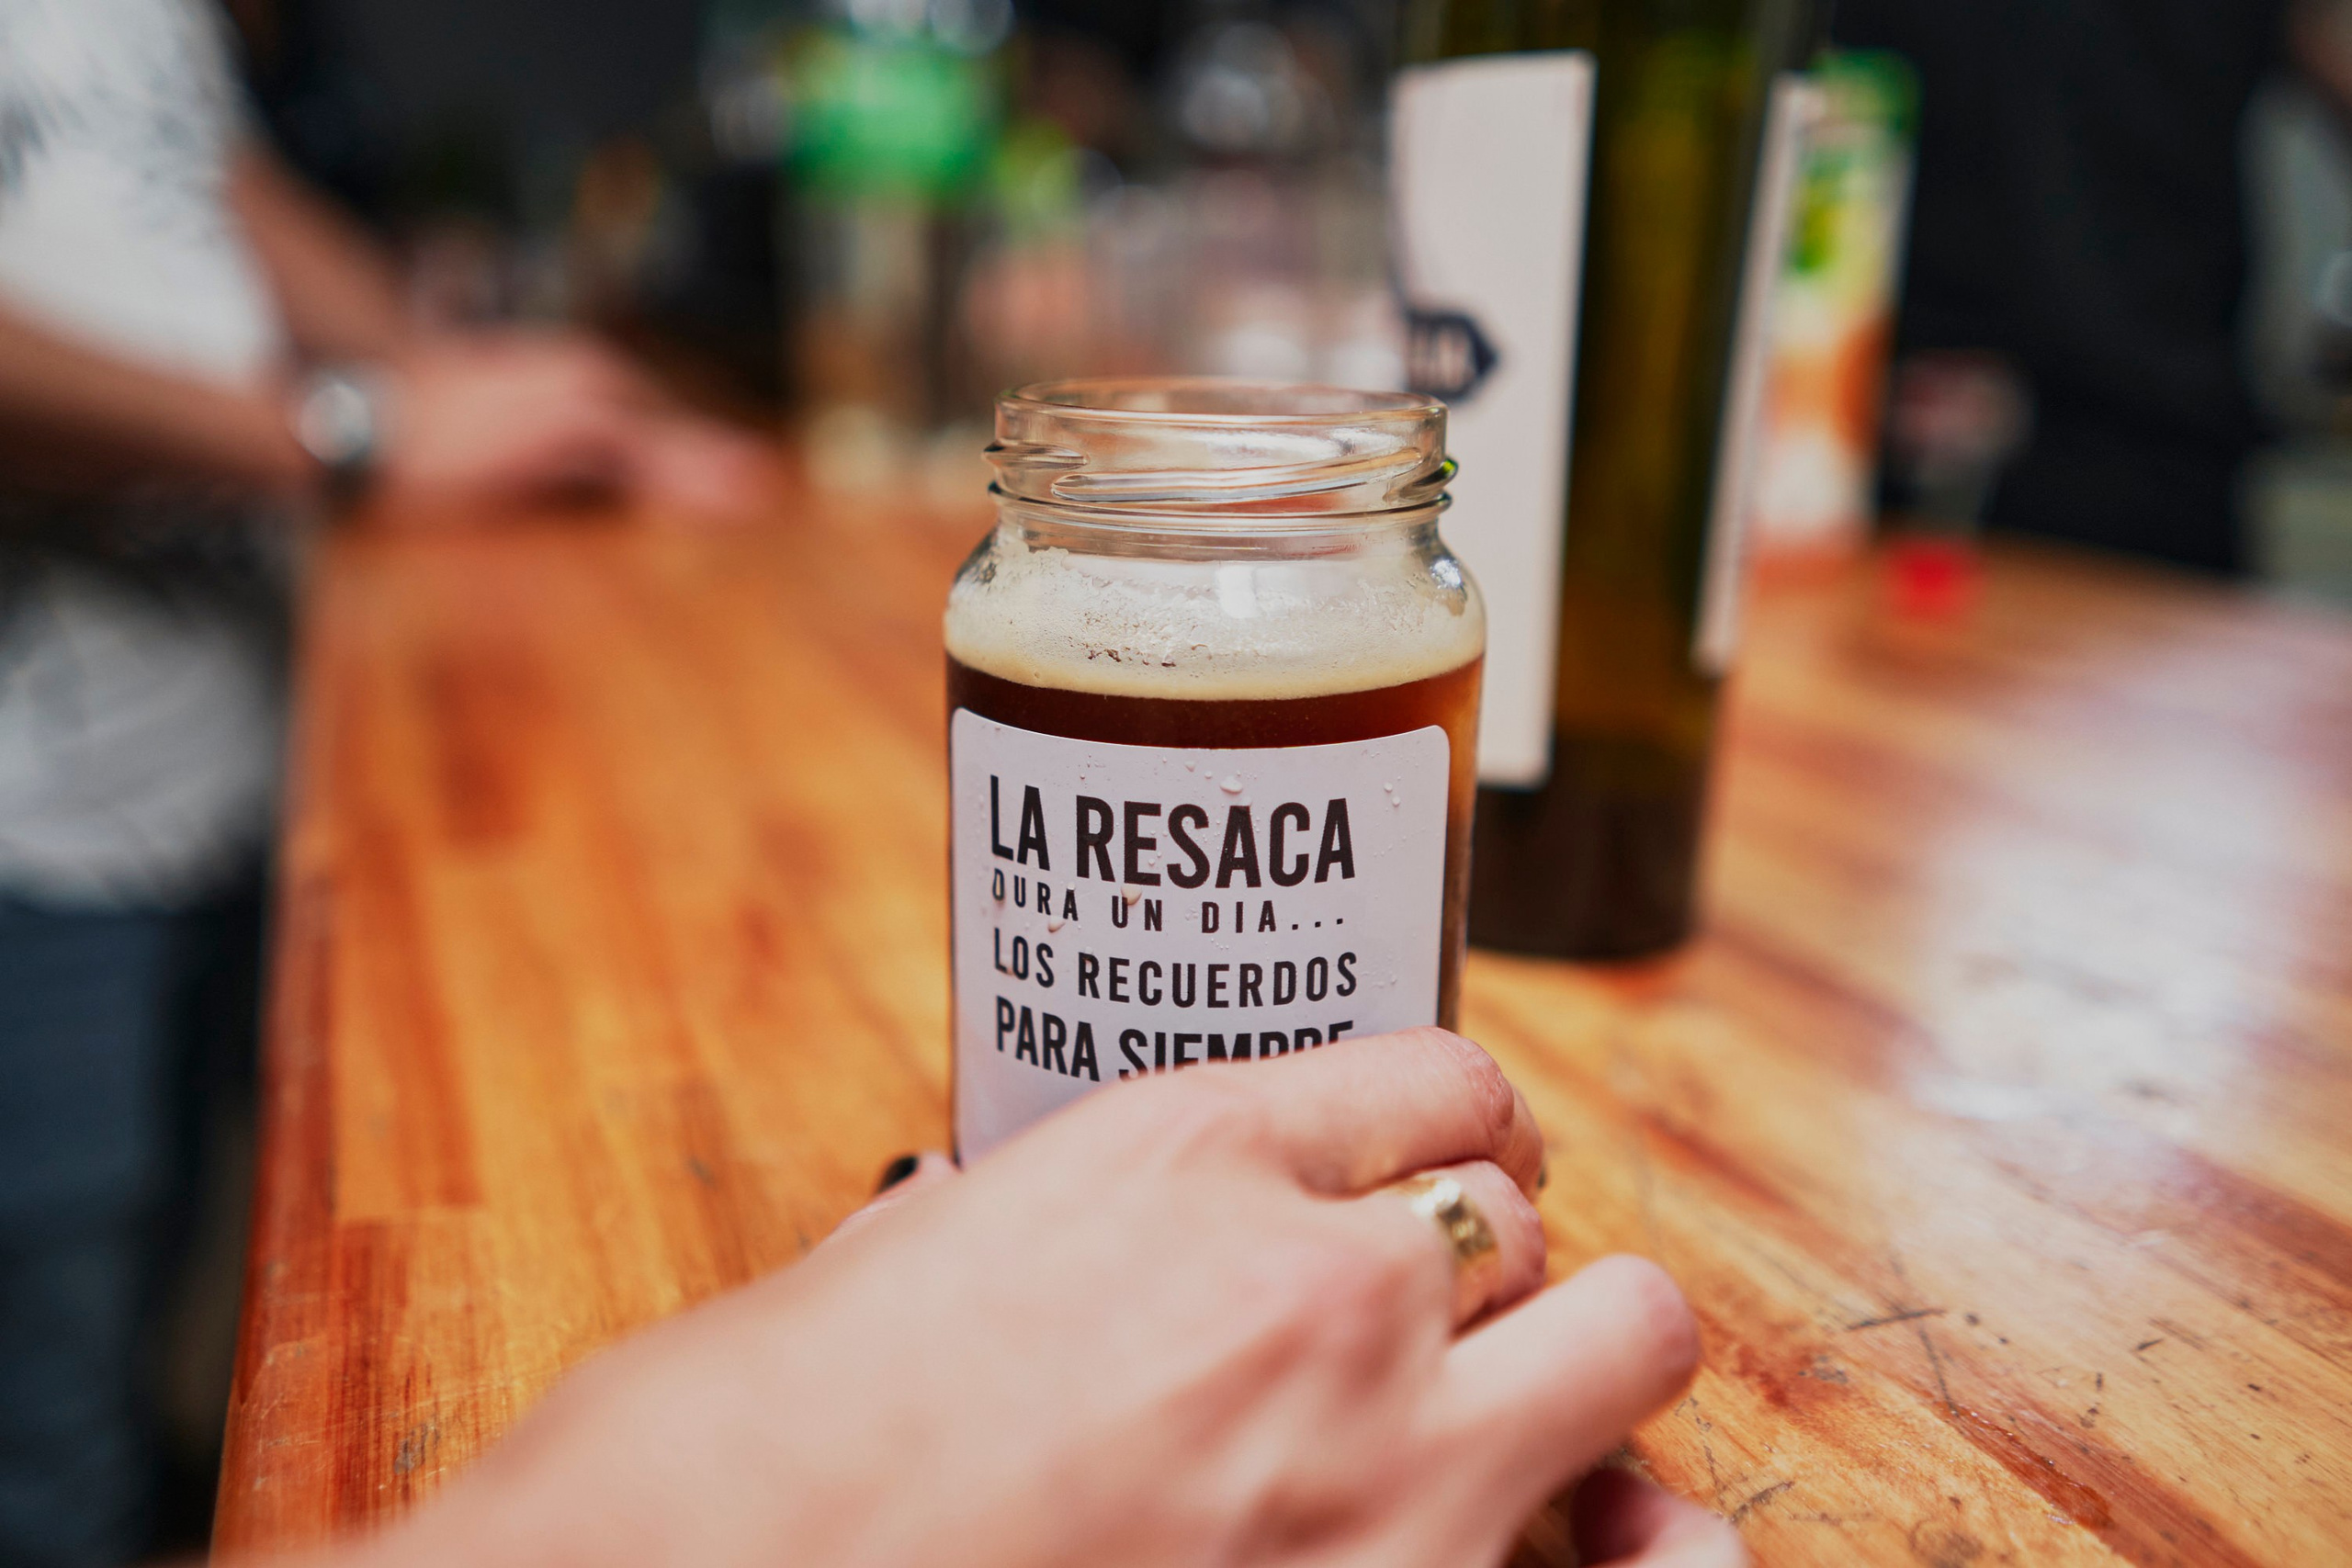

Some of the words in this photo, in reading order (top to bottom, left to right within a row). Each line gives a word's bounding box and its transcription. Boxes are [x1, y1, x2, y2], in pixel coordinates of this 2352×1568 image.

[989, 774, 1051, 872] LA
[1076, 795, 1355, 889] RESACA
[991, 867, 1079, 921] DURA
[1111, 895, 1162, 932] UN
[1201, 899, 1343, 934] DIA...
[994, 927, 1055, 988] LOS
[1078, 952, 1357, 1010] RECUERDOS
[996, 995, 1101, 1083] PARA
